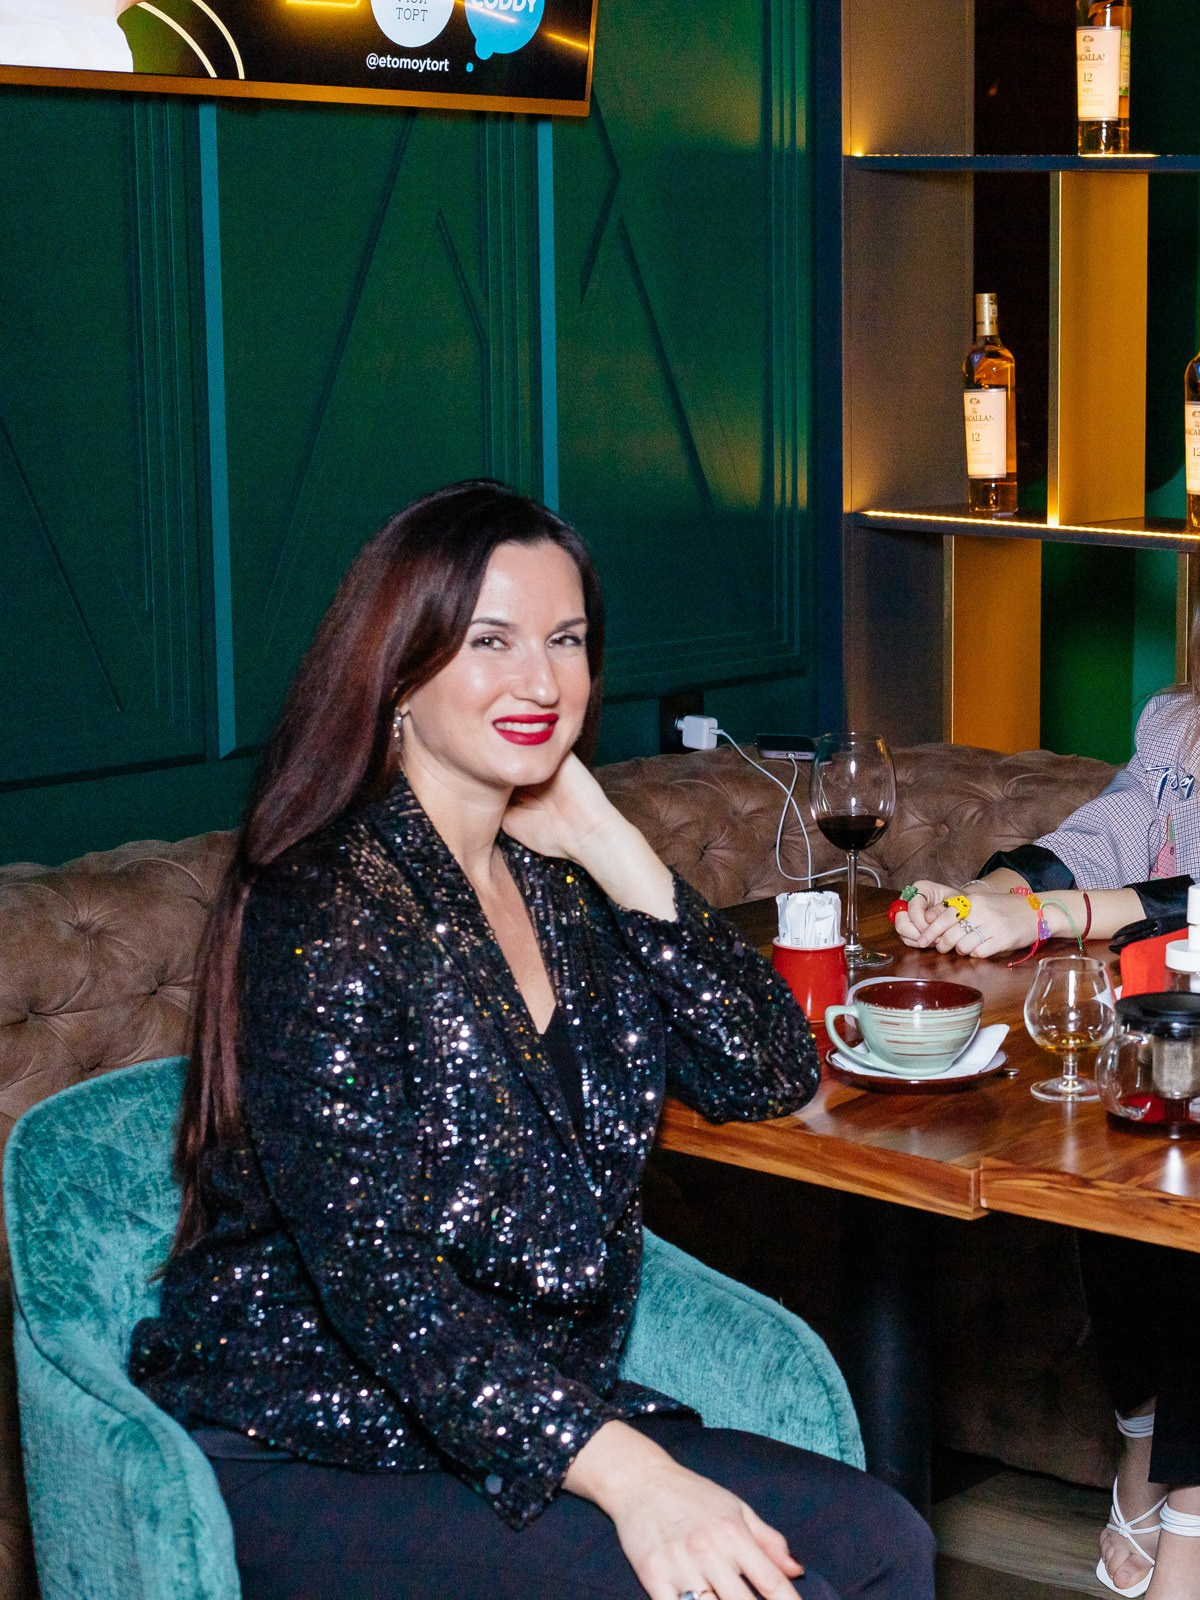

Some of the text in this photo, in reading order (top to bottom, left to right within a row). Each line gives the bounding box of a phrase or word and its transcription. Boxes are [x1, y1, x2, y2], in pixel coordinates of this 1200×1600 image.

[395, 7, 429, 22] ТОРТ
[365, 52, 450, 73] @etomoytort
[1083, 72, 1093, 83] 12
[970, 432, 981, 442] 12
